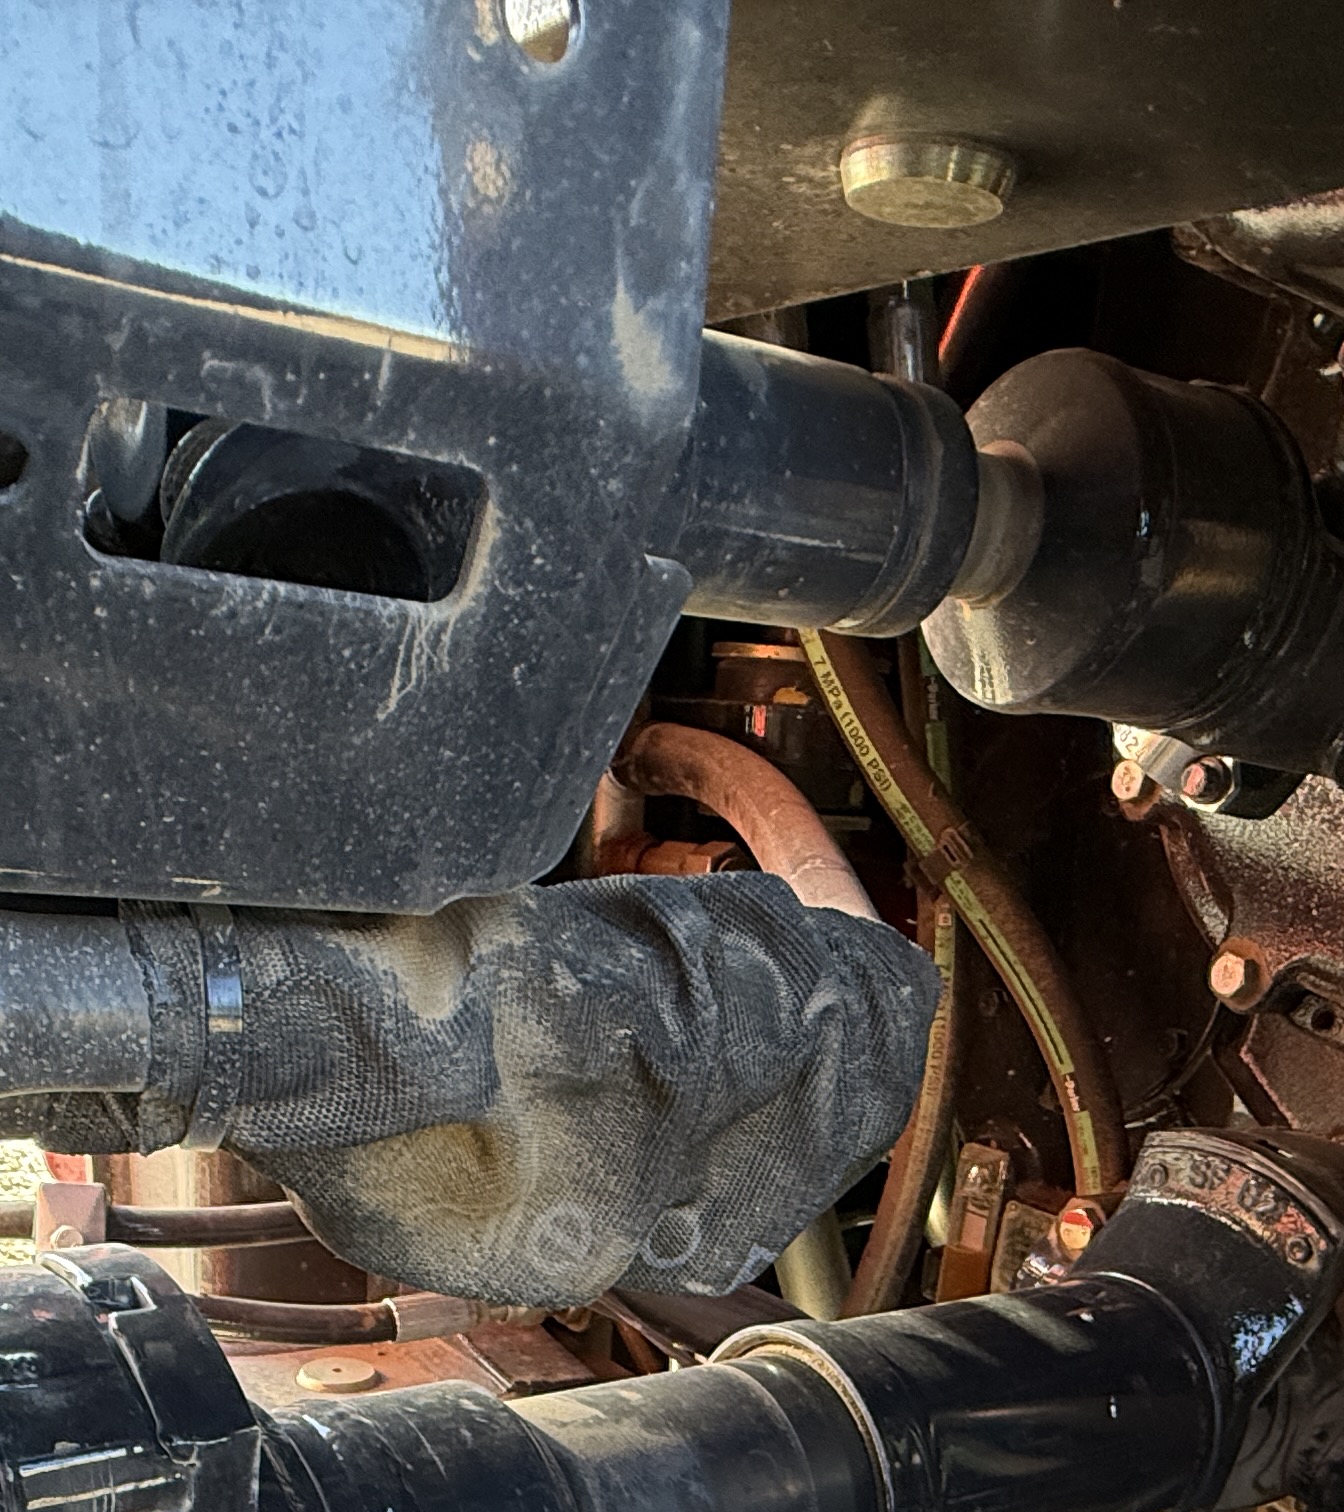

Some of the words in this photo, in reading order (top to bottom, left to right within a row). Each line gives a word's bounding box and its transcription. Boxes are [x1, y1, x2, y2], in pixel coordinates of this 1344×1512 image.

[819, 670, 844, 711] MPa
[839, 710, 872, 759] (1000
[865, 757, 894, 793] PSI)
